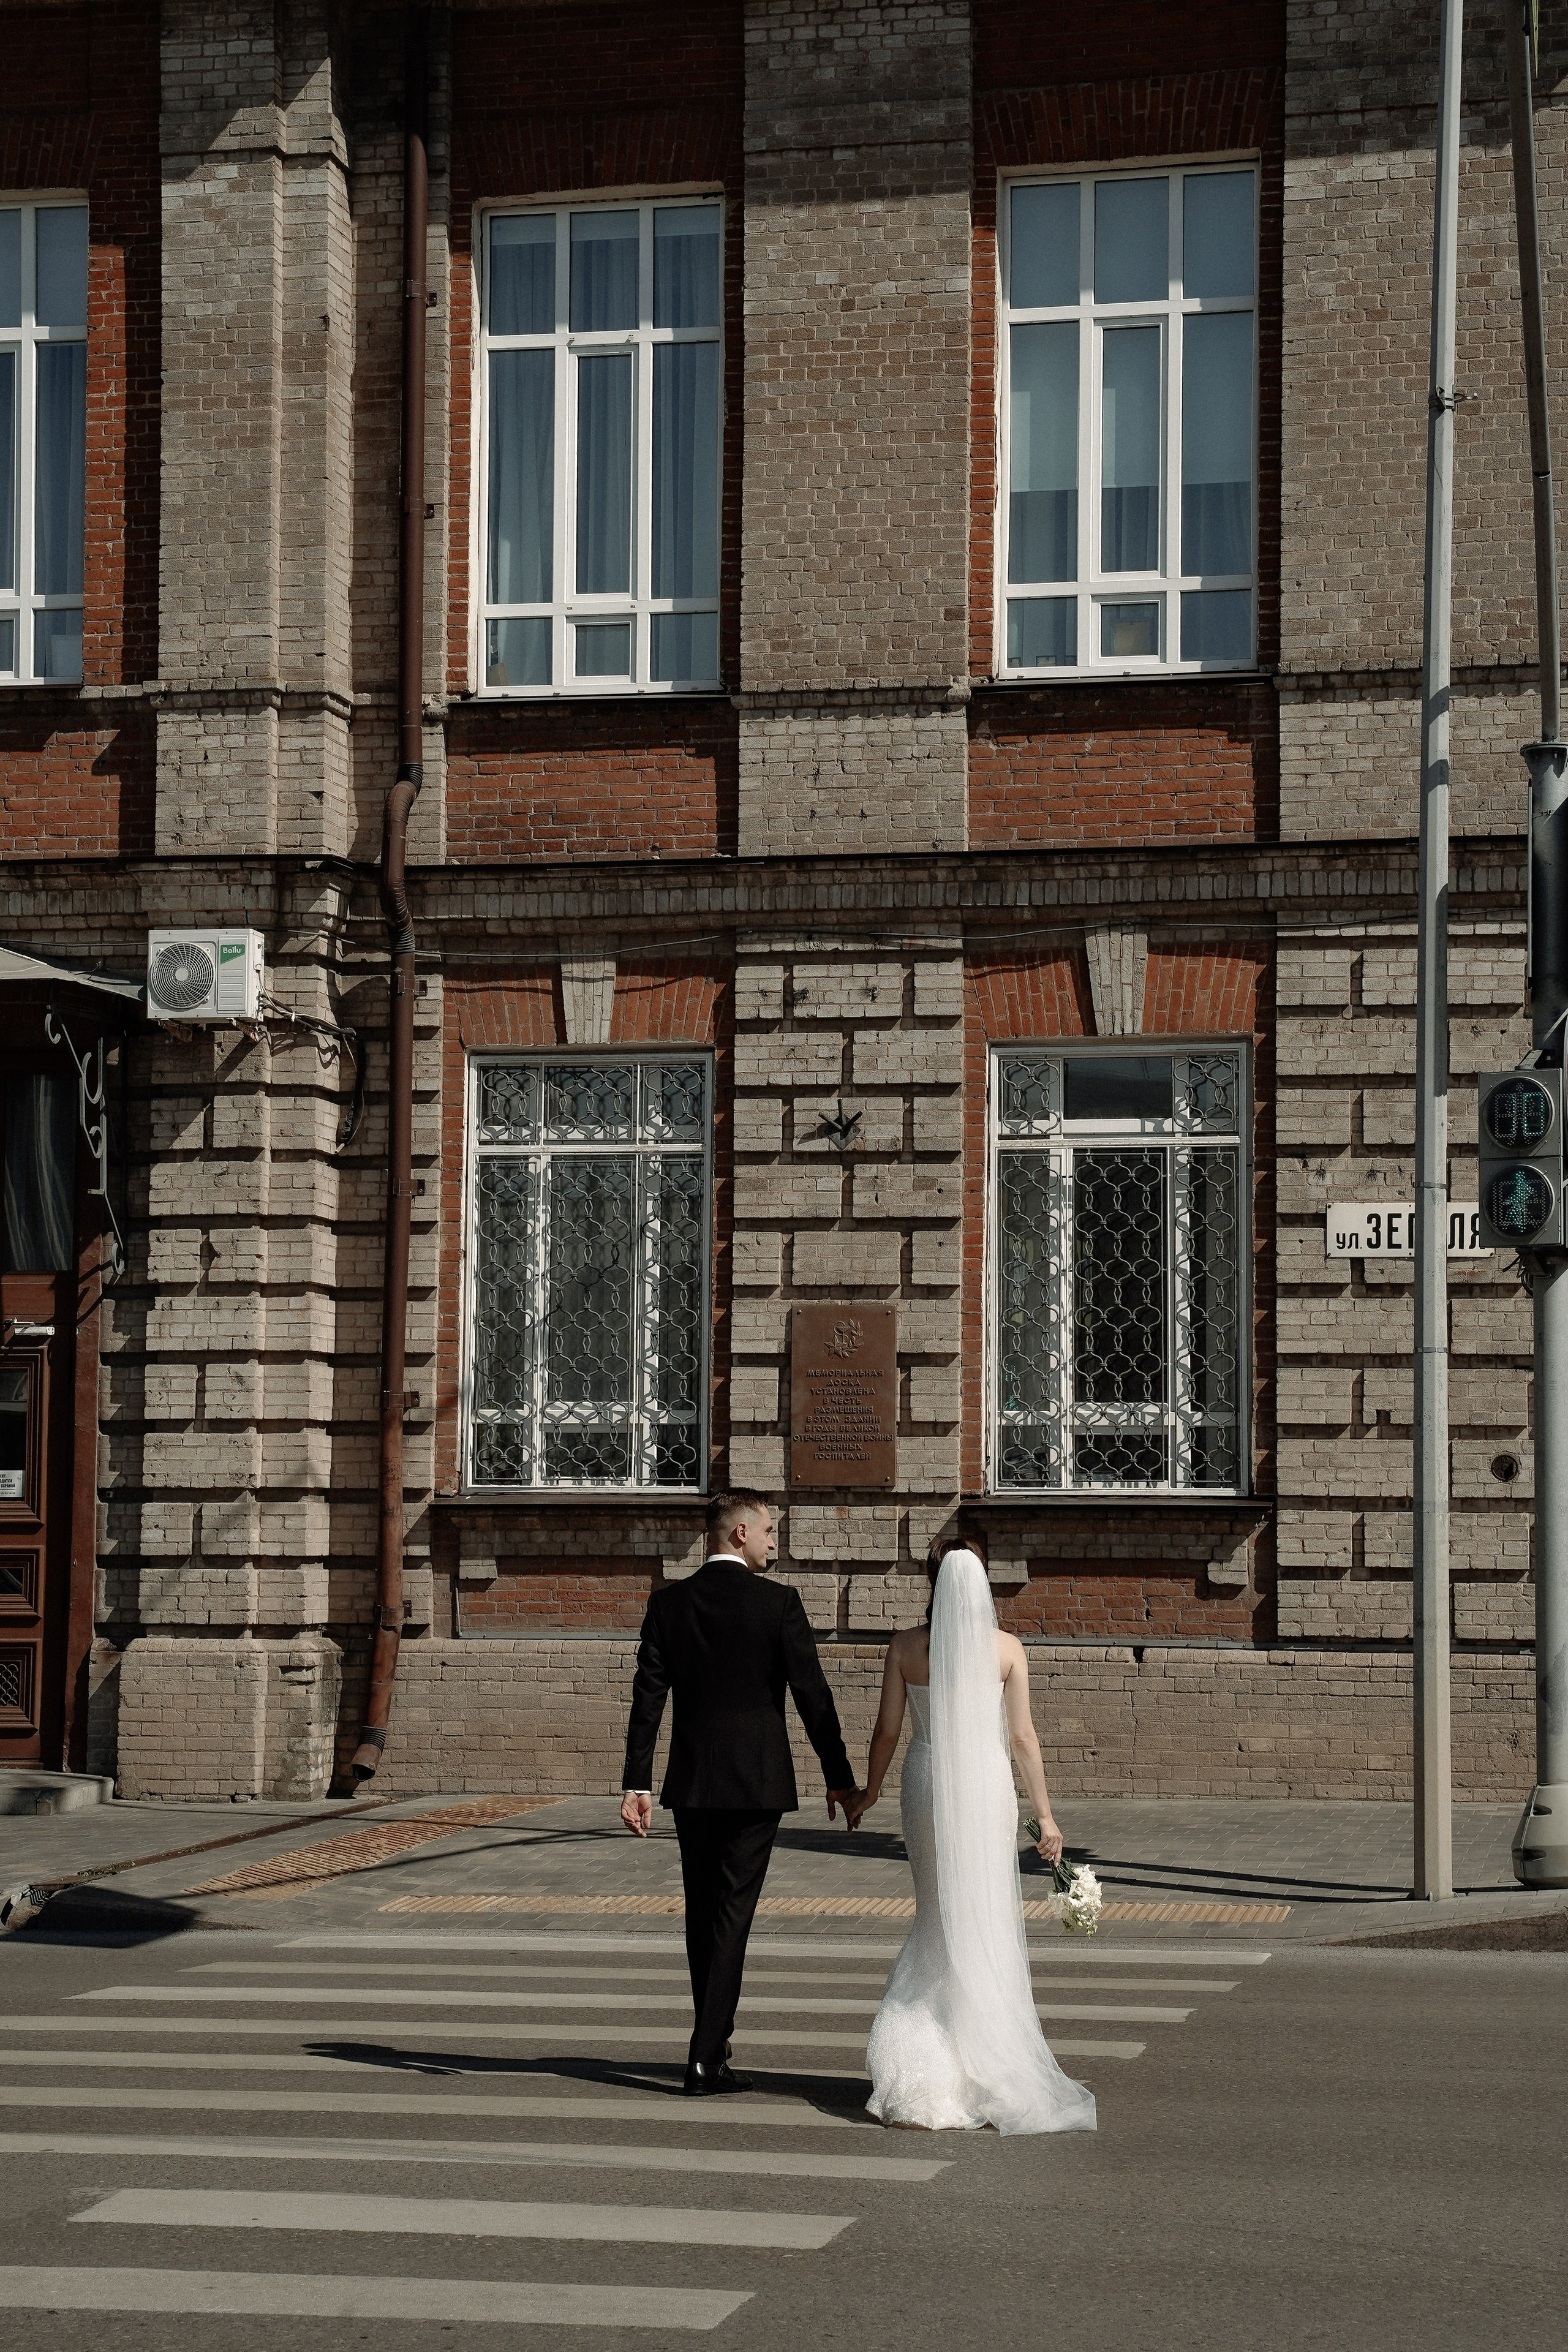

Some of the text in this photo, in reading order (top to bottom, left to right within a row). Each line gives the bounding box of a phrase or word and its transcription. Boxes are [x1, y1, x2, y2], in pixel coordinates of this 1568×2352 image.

[1336, 1232, 1362, 1250] ул.
[806, 1369, 884, 1378] МЕМОРИАЛЬНАЯ
[826, 1378, 861, 1387] ДОСКА
[814, 1406, 873, 1414] РАЗМЕЩЕНИЯ
[840, 1424, 880, 1433] ВЕЛИКОЙ
[793, 1433, 894, 1442] ОТЕЧЕСТВЕННОЙ ВОЙНЫ
[814, 1452, 871, 1460] ГОСПИТАЛЕЙ
